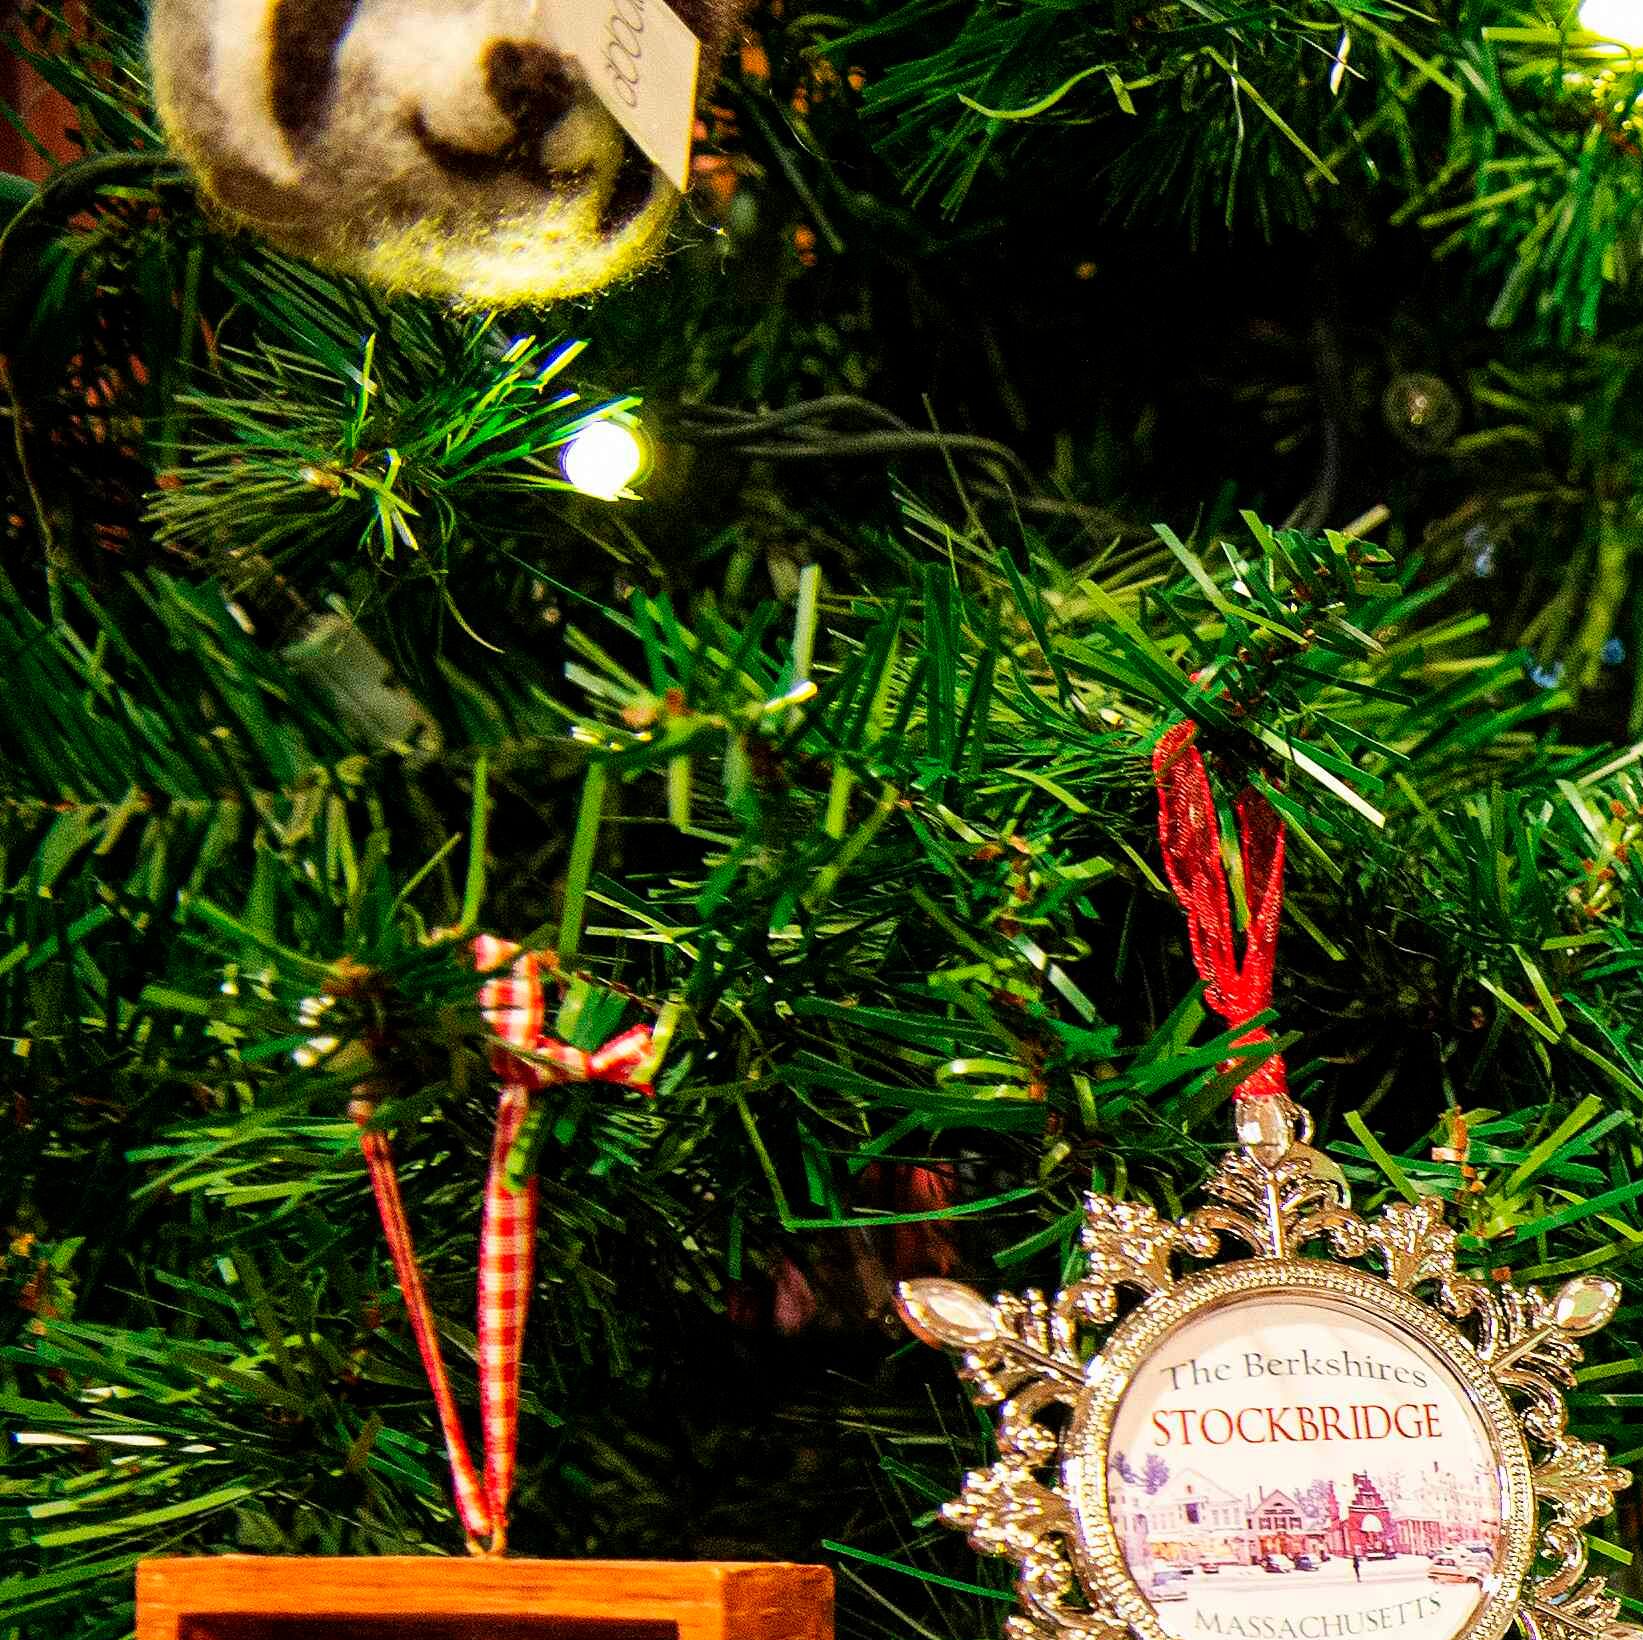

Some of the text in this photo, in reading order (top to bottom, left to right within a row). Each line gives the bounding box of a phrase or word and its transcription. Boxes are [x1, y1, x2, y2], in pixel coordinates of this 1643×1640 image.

[1161, 1349, 1428, 1391] The Berkshires
[1151, 1403, 1442, 1446] STOCKBRIDGE
[1194, 1591, 1440, 1640] MASSACHUSETTS
